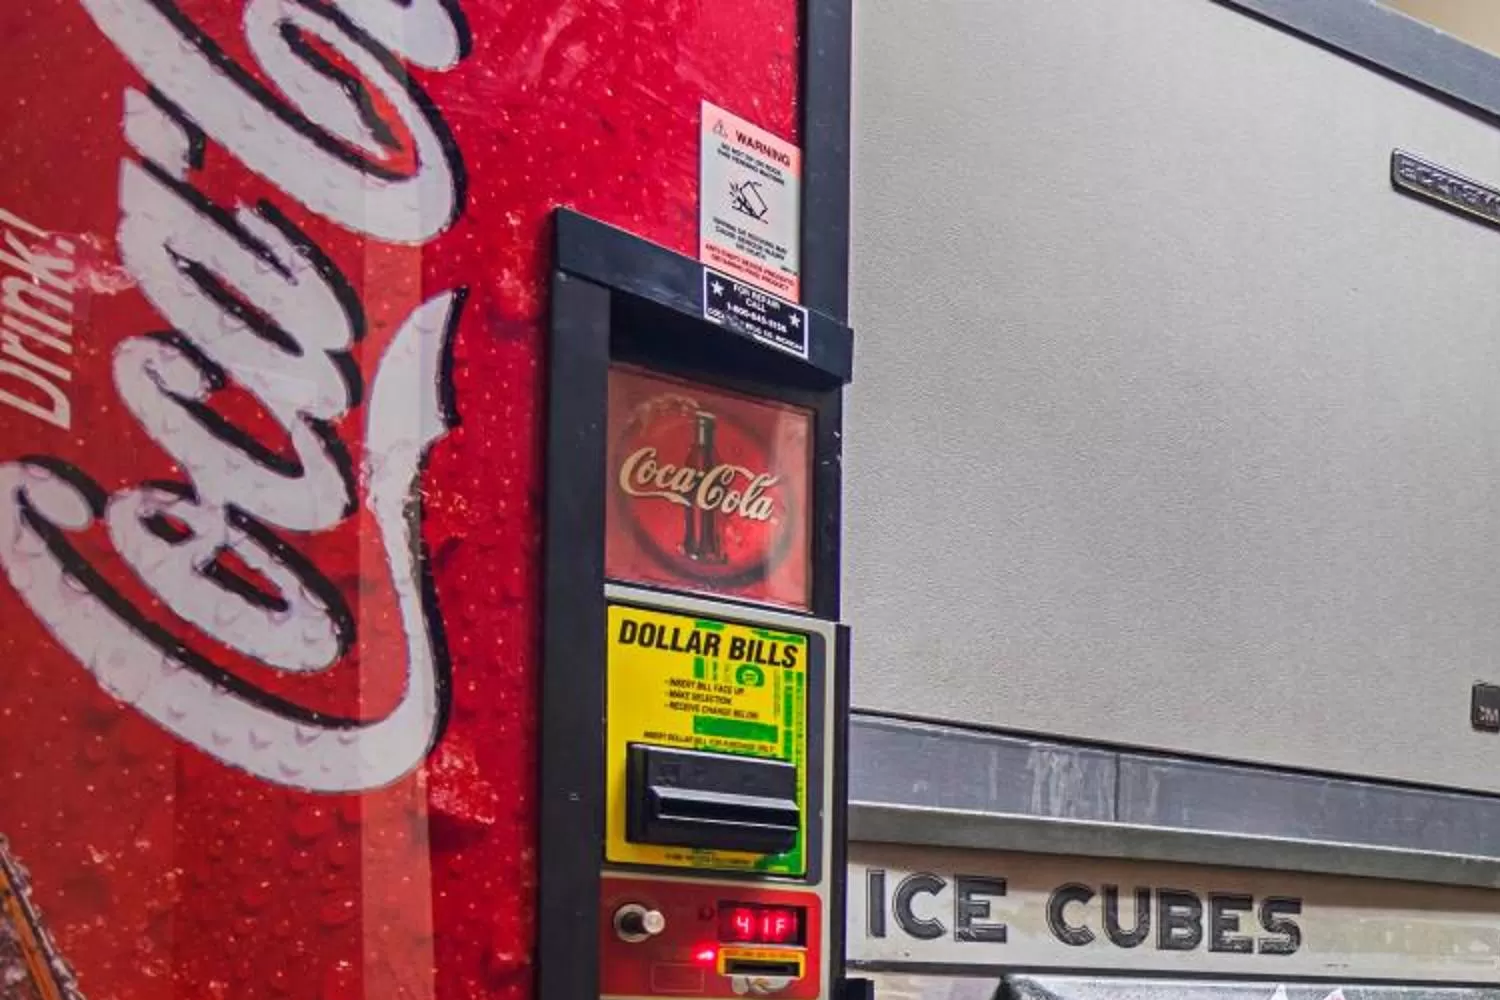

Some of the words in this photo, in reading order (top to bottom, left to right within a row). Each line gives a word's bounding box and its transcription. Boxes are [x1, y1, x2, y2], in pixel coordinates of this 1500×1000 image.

[735, 130, 791, 168] WARNING
[618, 619, 721, 657] DOLLAR
[728, 636, 798, 668] BILLS
[866, 868, 1008, 943] ICE
[1045, 881, 1303, 955] CUBES
